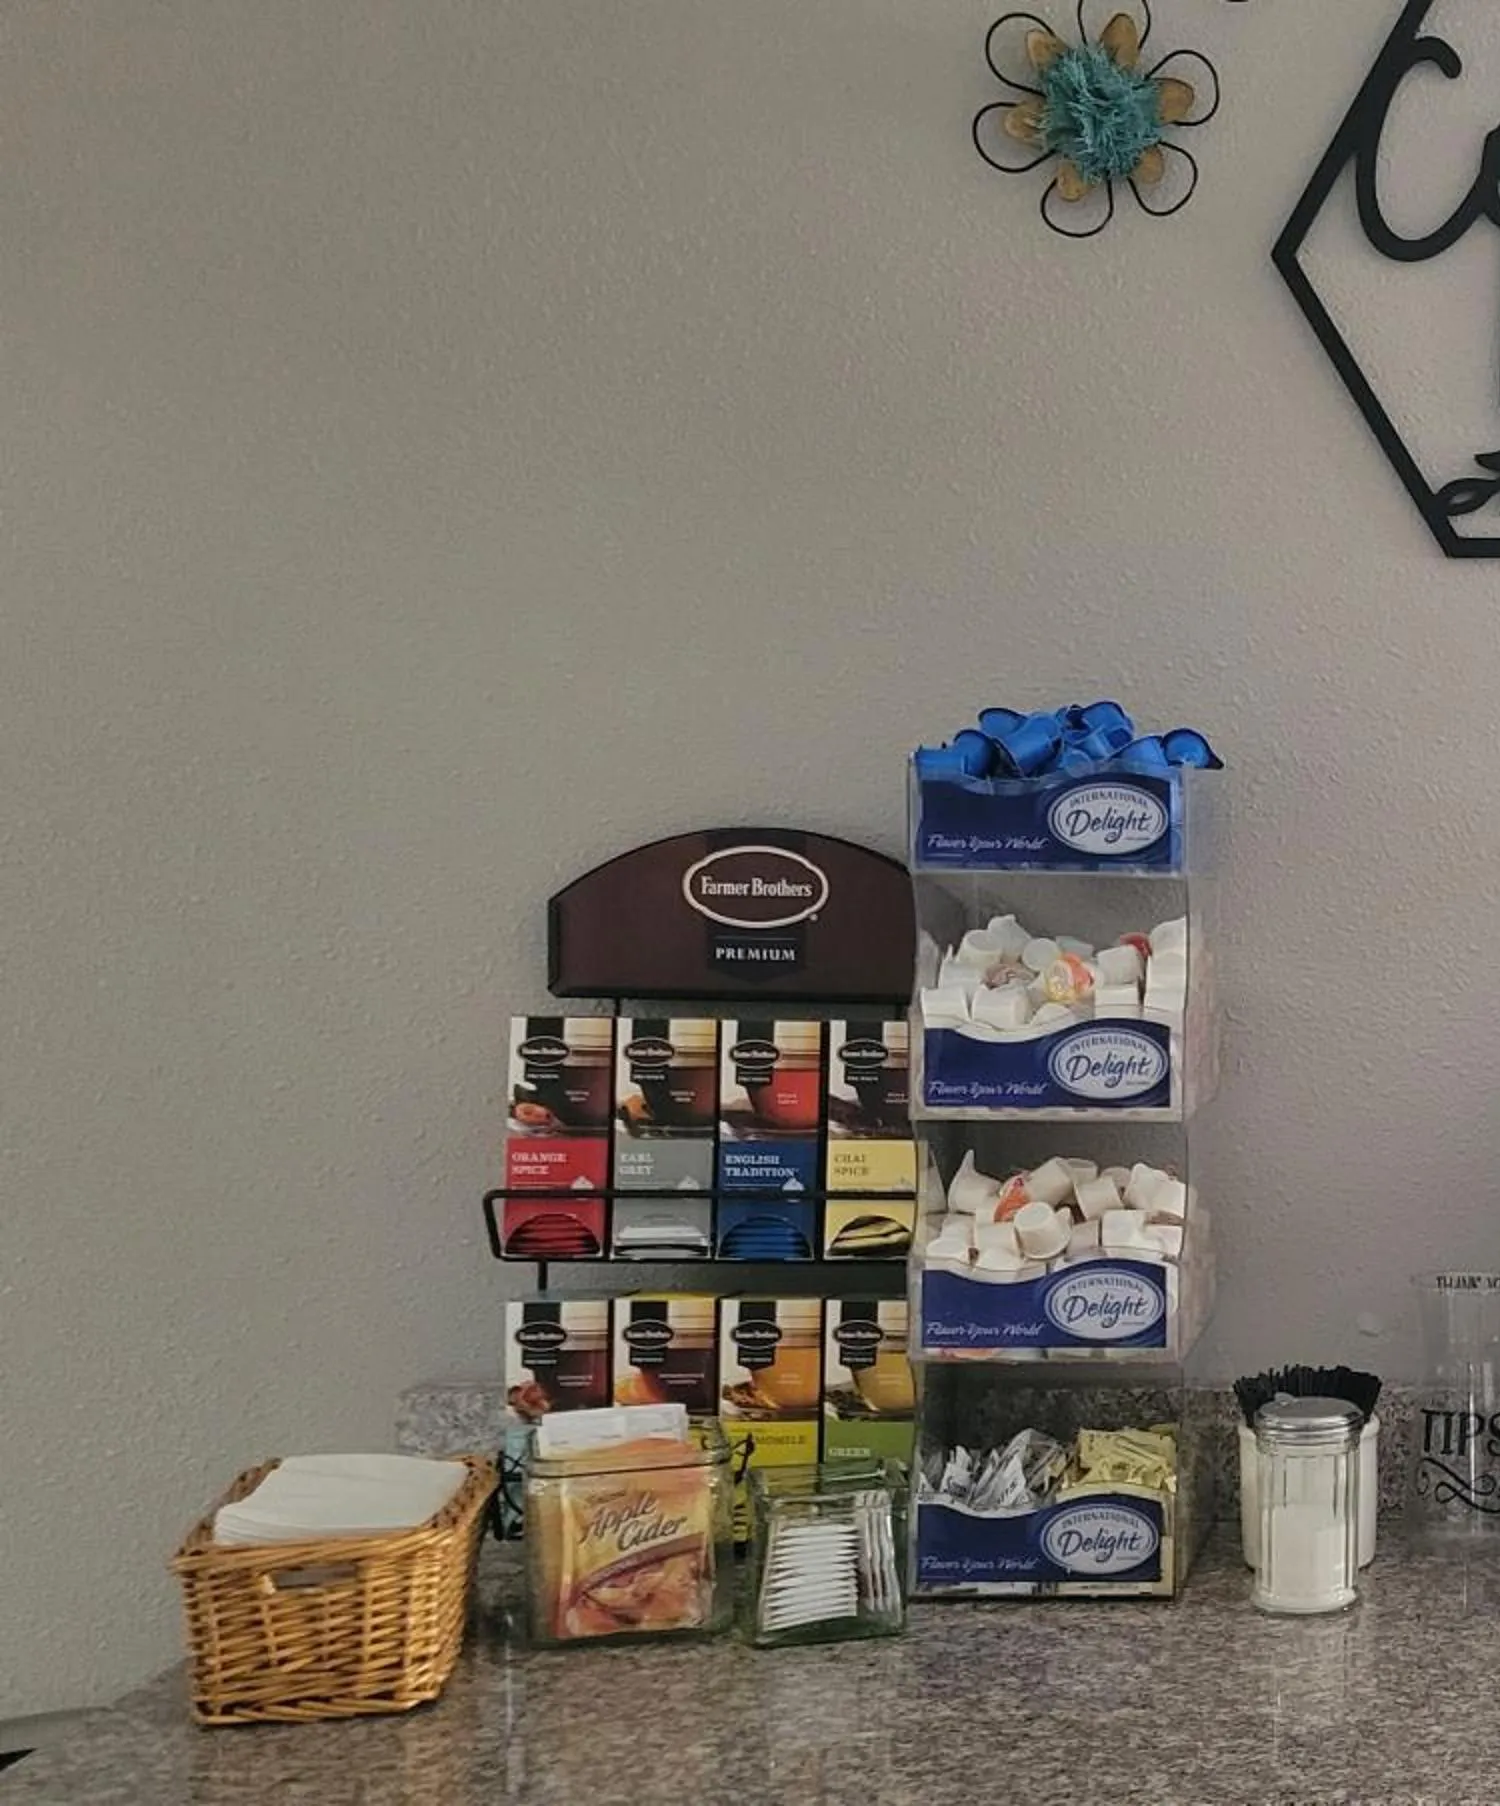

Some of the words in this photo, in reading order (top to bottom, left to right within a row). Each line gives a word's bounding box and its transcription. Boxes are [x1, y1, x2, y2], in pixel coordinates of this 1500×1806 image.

[1069, 790, 1147, 808] INTERNATIONAL
[1065, 807, 1153, 844] Delight
[700, 874, 751, 896] Farmer
[751, 876, 813, 897] Brothers
[715, 946, 796, 961] PREMIUM
[1069, 1034, 1147, 1052] INTERNATIONAL
[1065, 1051, 1152, 1088] Delight
[511, 1151, 567, 1163] ORANGE
[619, 1152, 654, 1163] EARL
[724, 1154, 780, 1166] ENGLISH
[511, 1164, 550, 1176] SPICE
[619, 1164, 654, 1176] GREY
[1066, 1276, 1144, 1294] INTERNATIONAL
[1063, 1292, 1149, 1329] Delight
[578, 1491, 660, 1544] Apple
[1060, 1511, 1140, 1530] INTERNATIONAL
[617, 1512, 689, 1551] Cider
[1057, 1527, 1144, 1563] Delight
